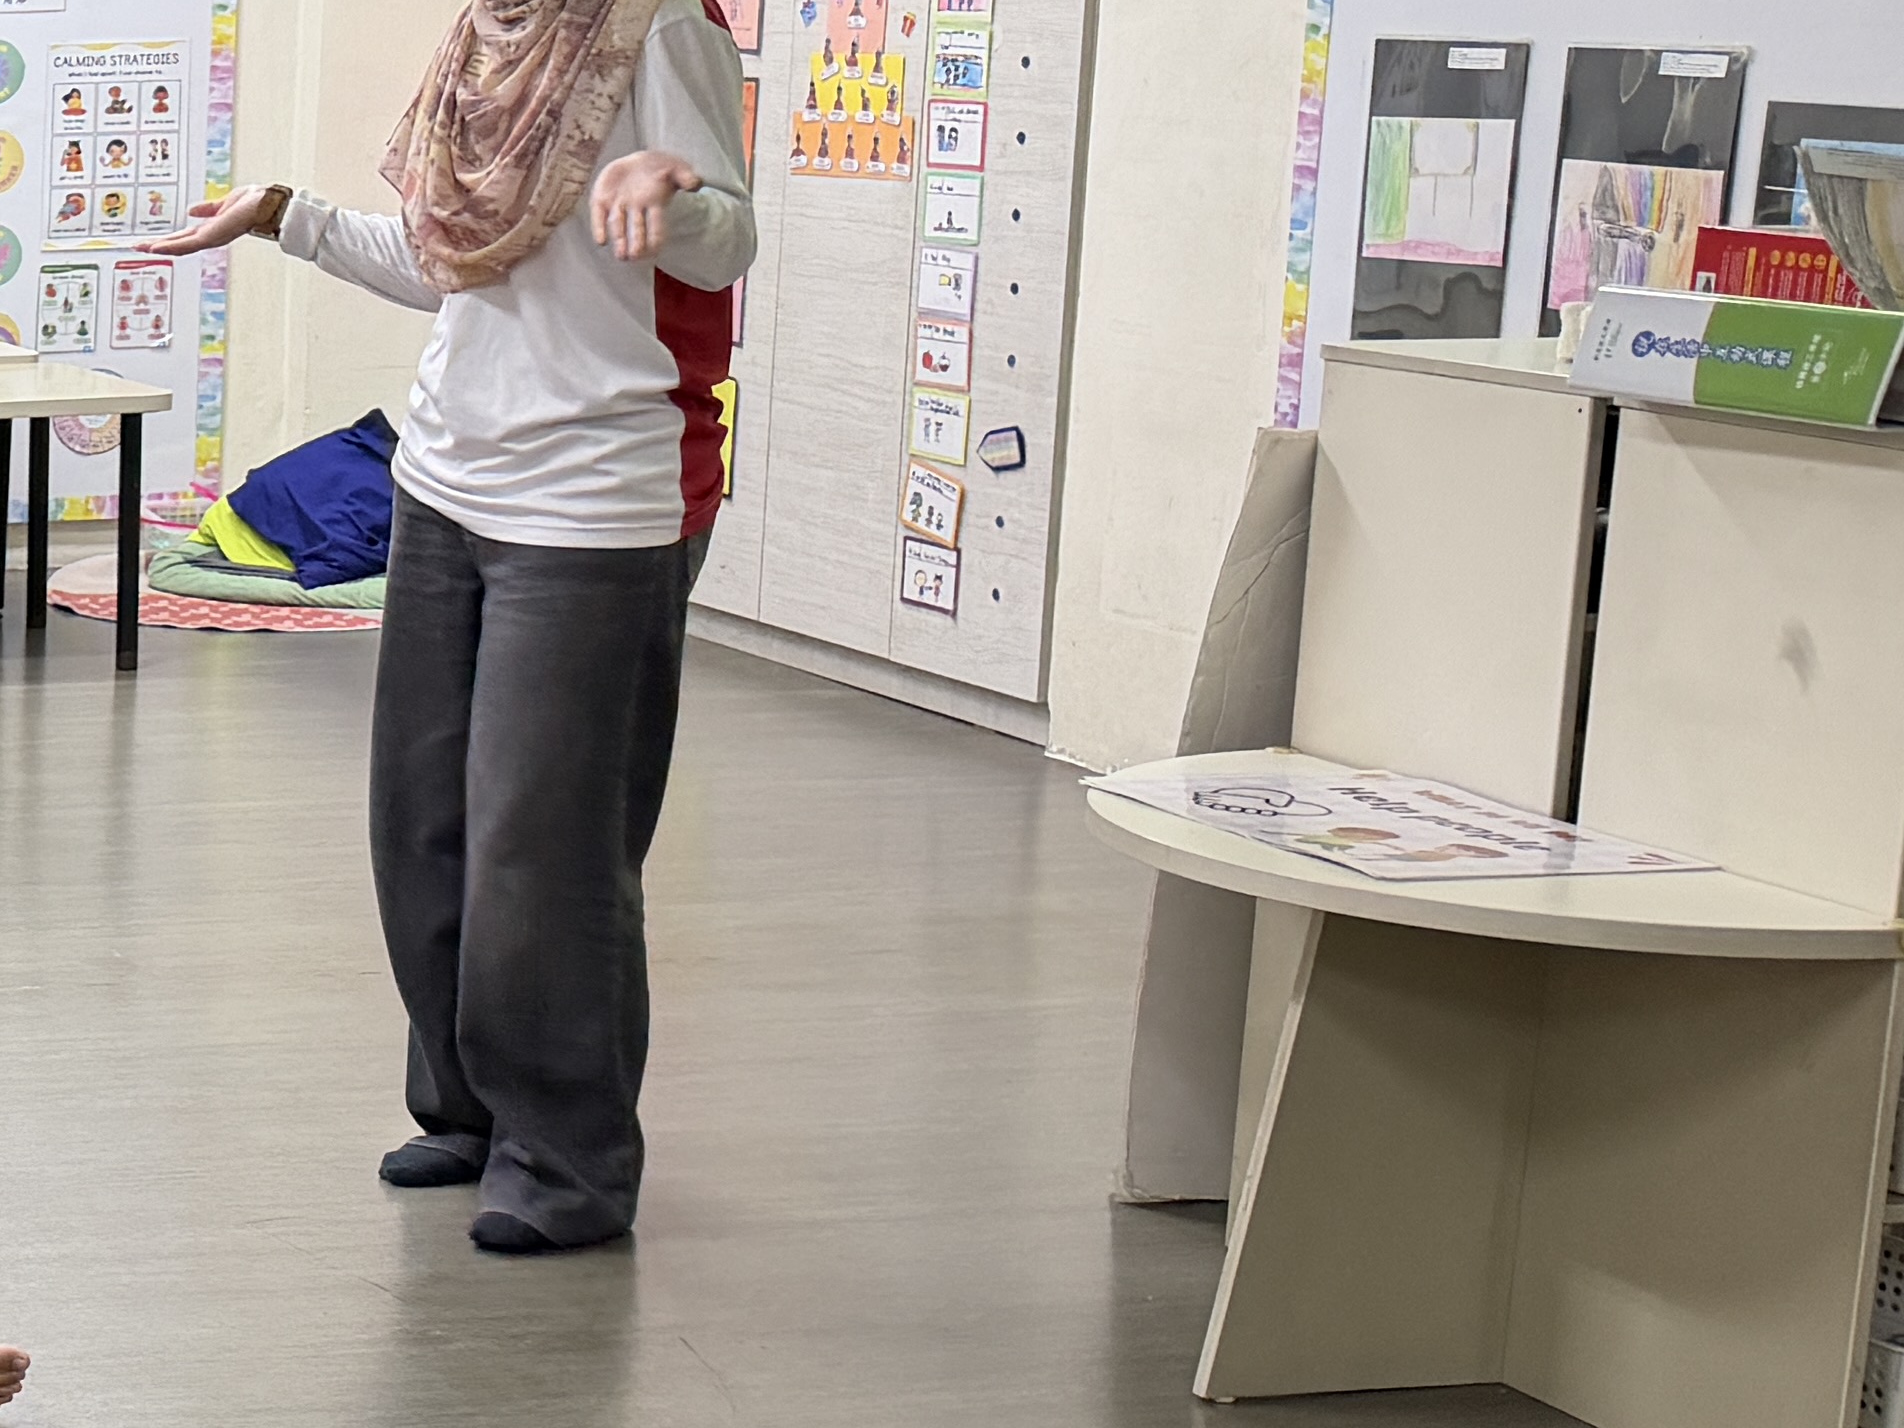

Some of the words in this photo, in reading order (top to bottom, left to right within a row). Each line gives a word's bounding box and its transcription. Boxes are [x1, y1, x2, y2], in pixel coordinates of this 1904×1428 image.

[53, 55, 107, 68] CALMING
[110, 53, 180, 67] STRATEGIES
[1327, 786, 1421, 814] Help
[1400, 814, 1551, 852] people
